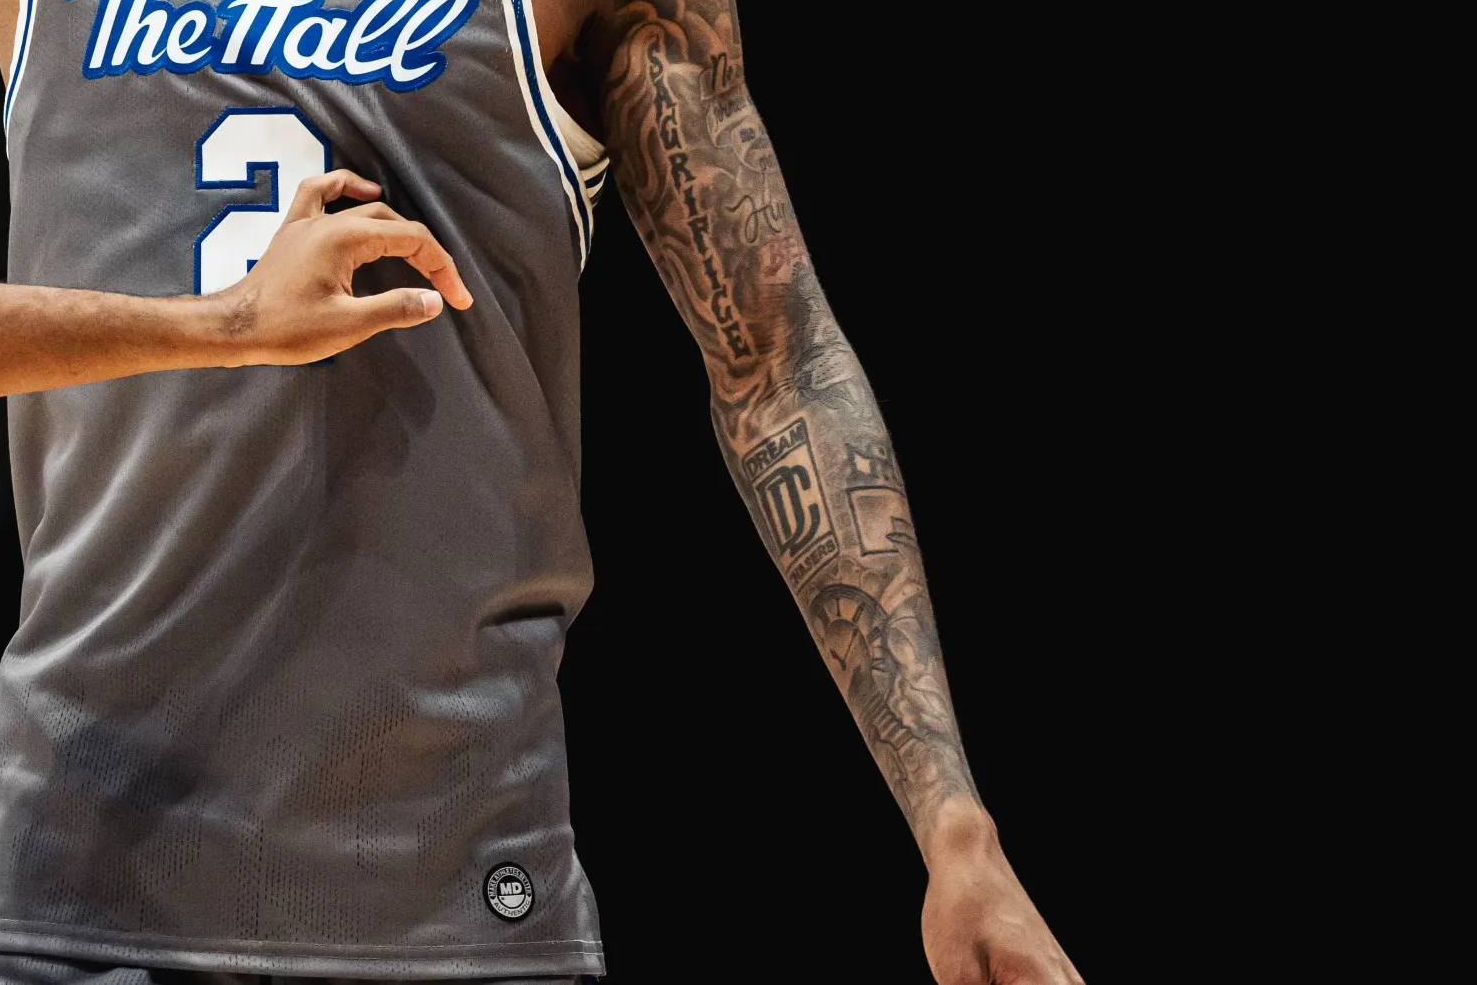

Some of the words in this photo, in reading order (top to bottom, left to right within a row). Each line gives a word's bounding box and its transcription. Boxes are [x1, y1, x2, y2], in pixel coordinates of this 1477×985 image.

[193, 106, 333, 365] 2
[499, 882, 522, 895] MD
[493, 899, 530, 916] AUTHENTIC
